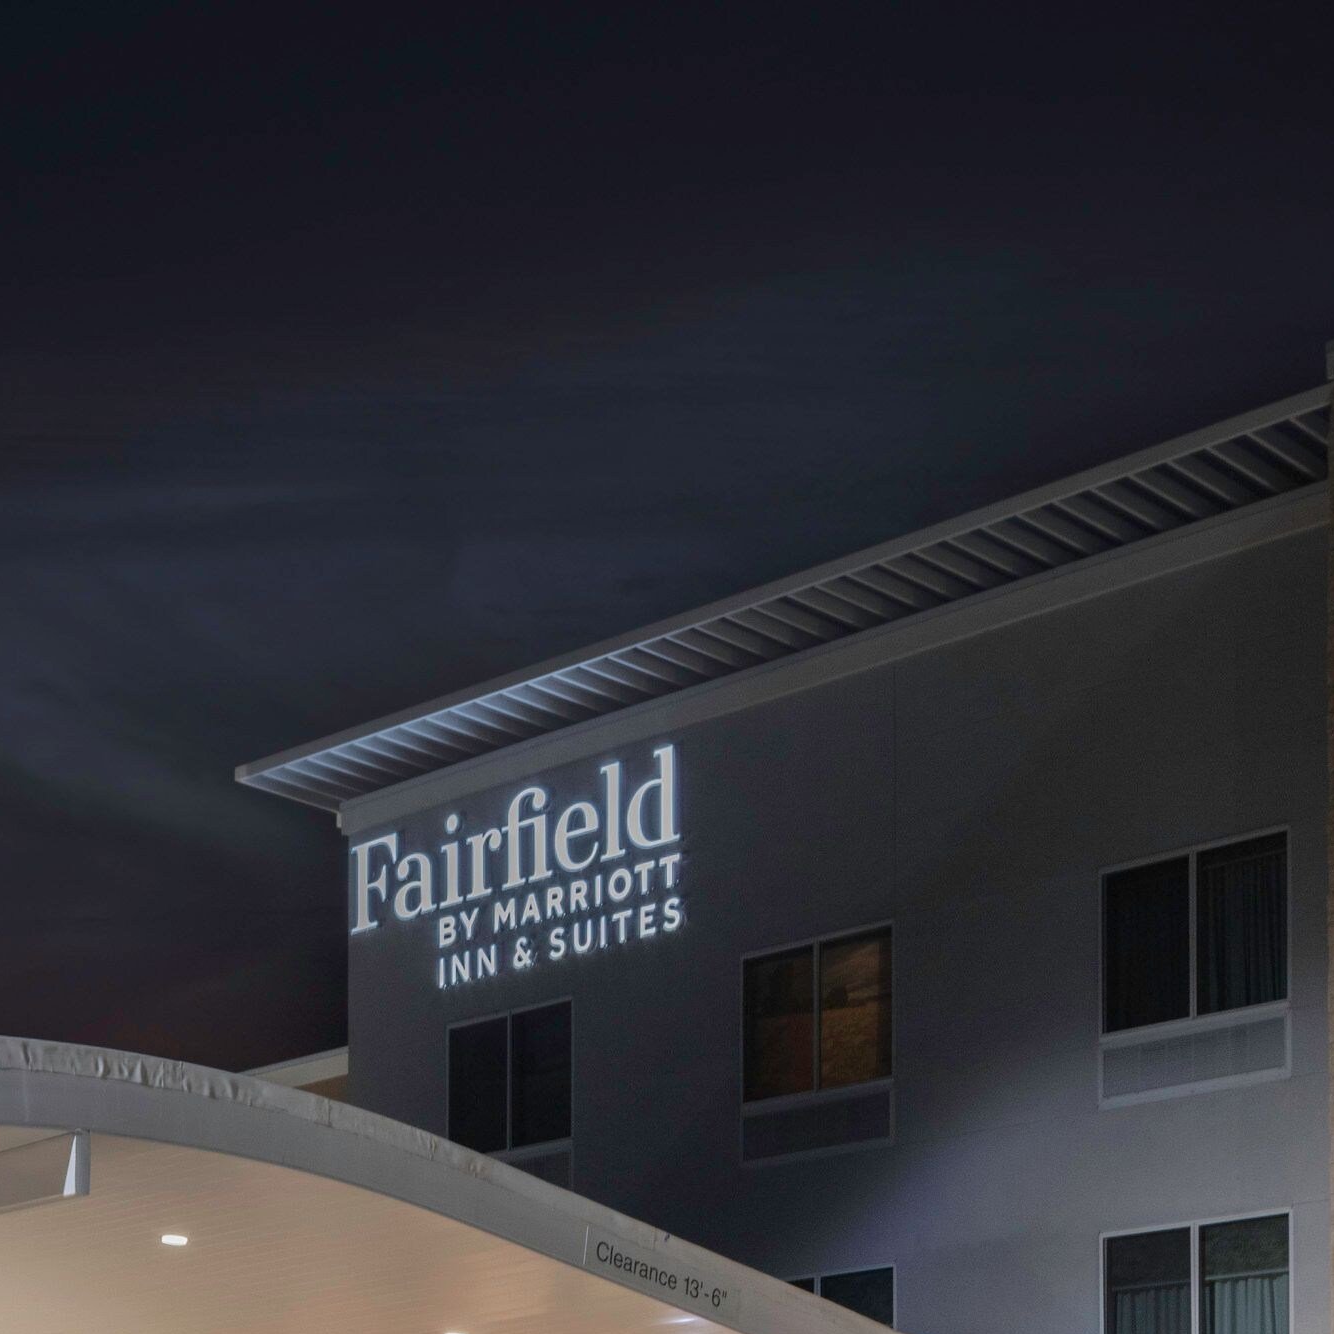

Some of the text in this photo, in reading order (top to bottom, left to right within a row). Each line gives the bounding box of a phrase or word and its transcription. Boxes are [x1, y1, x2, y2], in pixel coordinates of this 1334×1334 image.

[350, 744, 681, 936] Fairfield
[437, 897, 683, 989] INN & SUITES
[438, 853, 681, 948] BY MARRIOTT
[596, 1241, 728, 1308] Clearance 13'-6"
